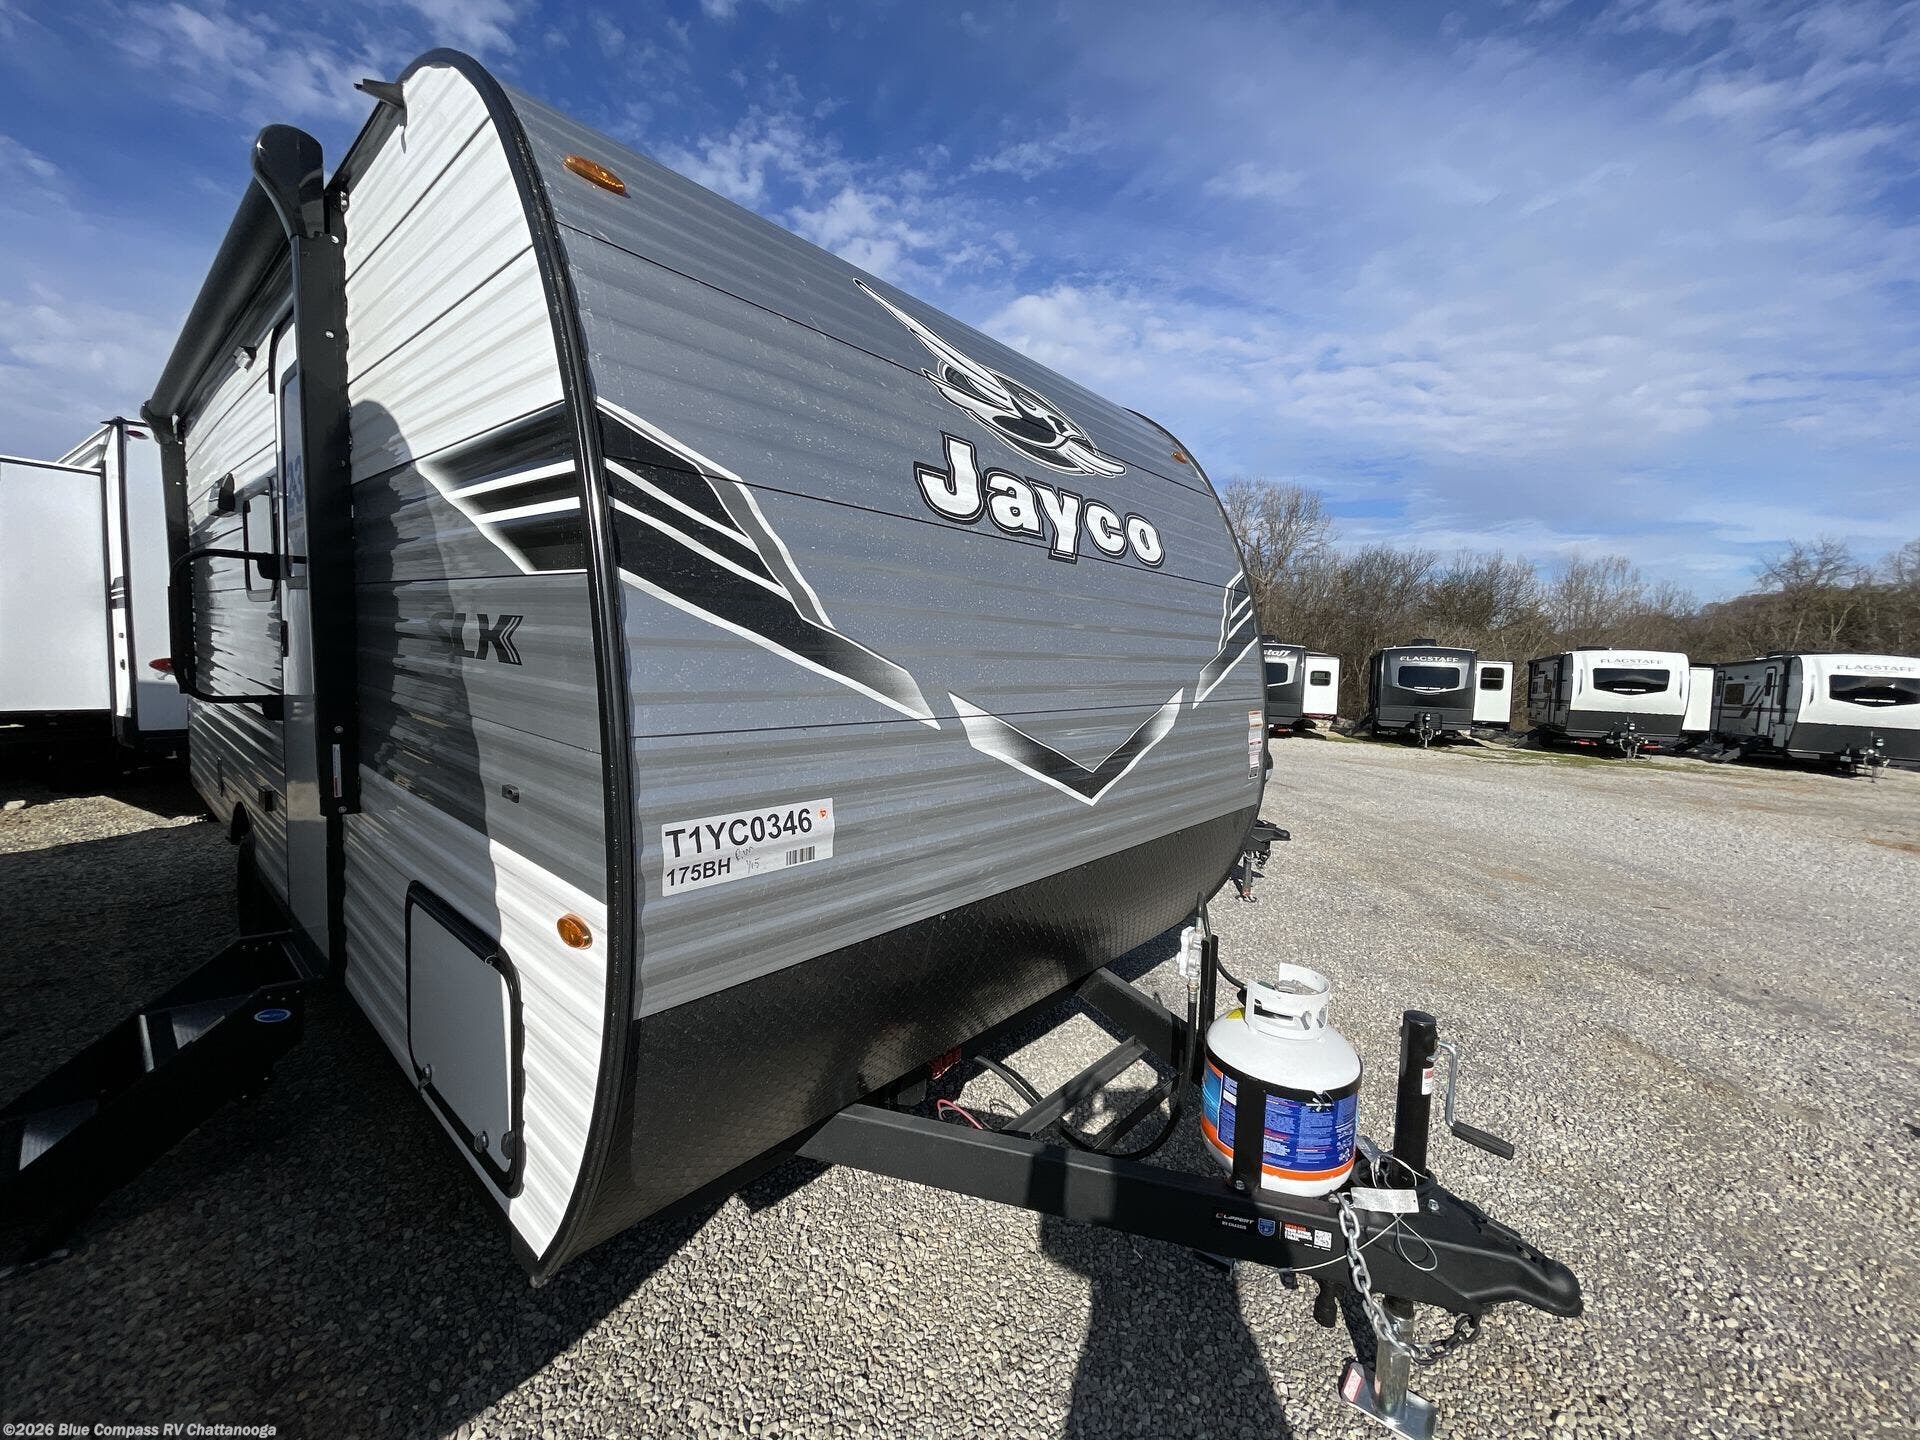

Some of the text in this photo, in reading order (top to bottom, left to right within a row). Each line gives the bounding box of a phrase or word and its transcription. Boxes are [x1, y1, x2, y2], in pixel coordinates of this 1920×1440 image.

[914, 430, 1165, 568] Jayco
[1400, 655, 1460, 663] FLAGSTAFF
[1836, 664, 1915, 673] FLAGSTAFF
[665, 808, 813, 859] T1YC0346
[666, 857, 731, 887] 175BH
